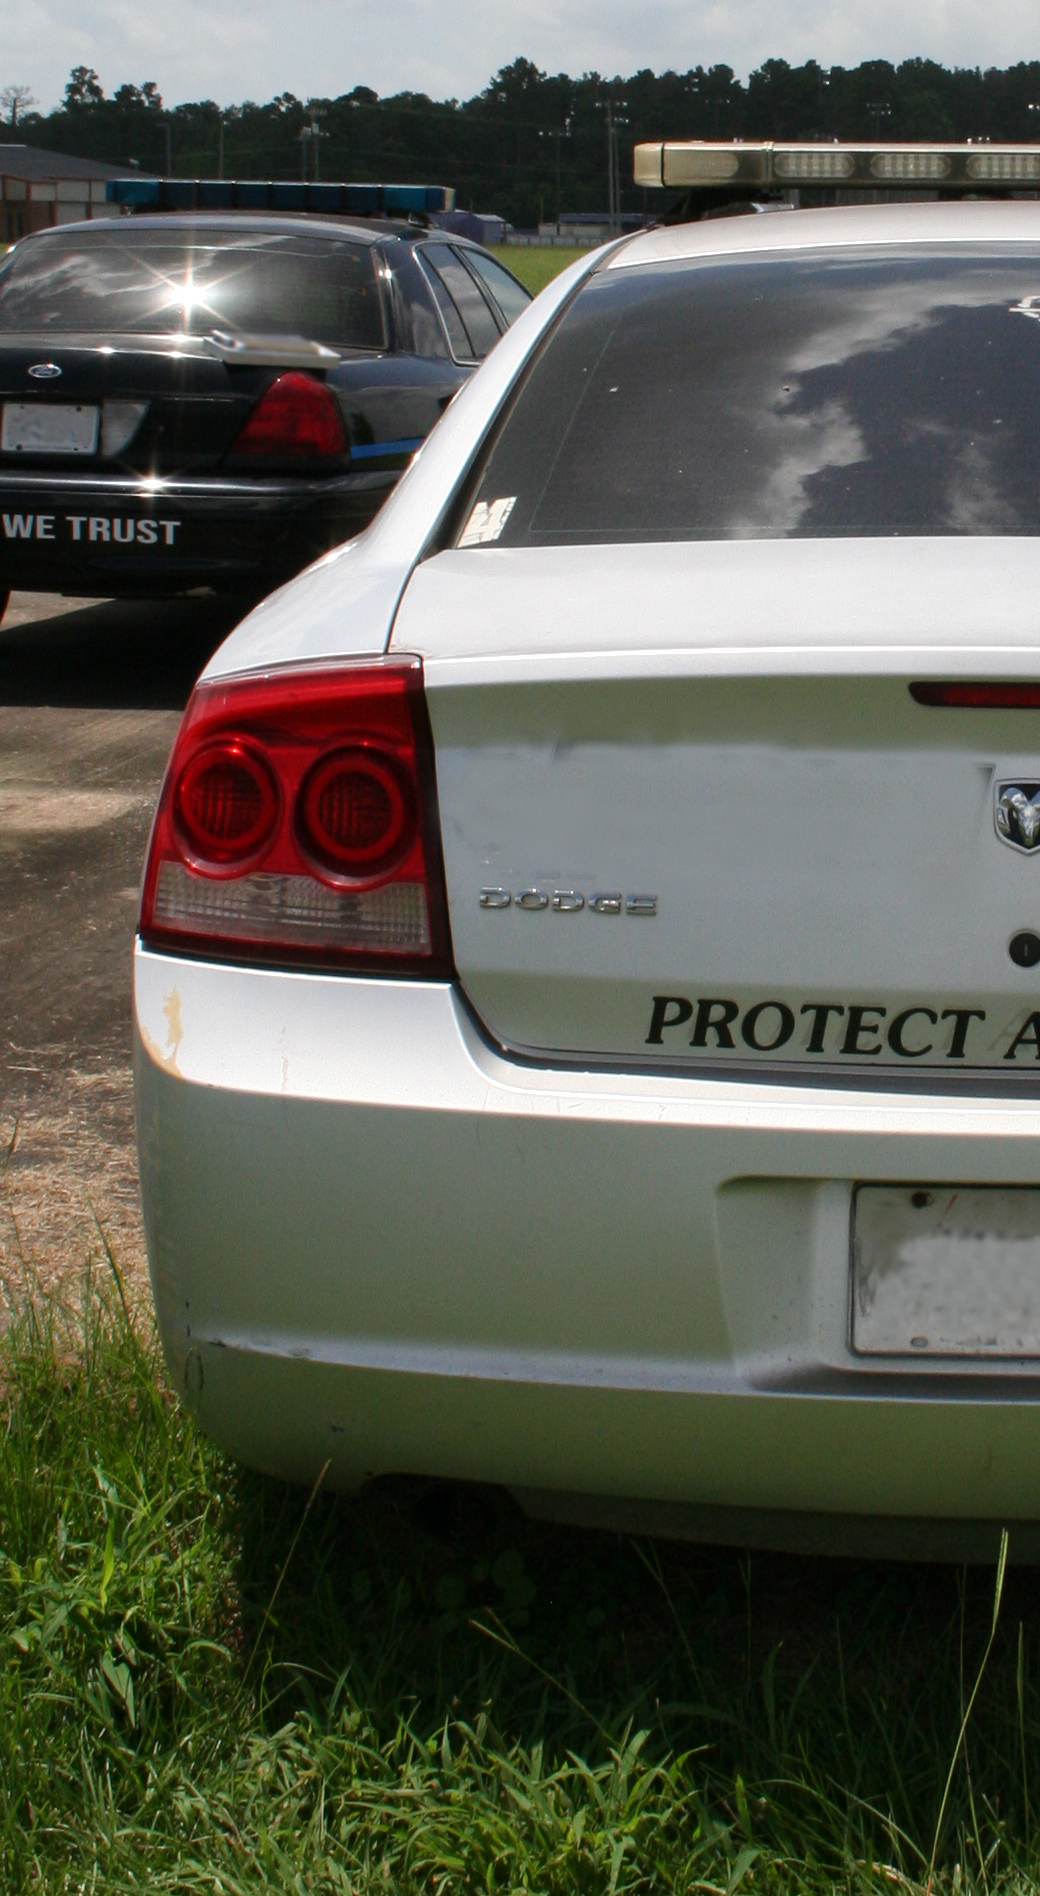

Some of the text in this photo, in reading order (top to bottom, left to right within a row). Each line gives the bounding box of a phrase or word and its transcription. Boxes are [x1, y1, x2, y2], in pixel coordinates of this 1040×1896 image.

[2, 513, 182, 545] WE TRUST
[478, 885, 658, 917] DODGE
[644, 995, 986, 1060] PROTECT
